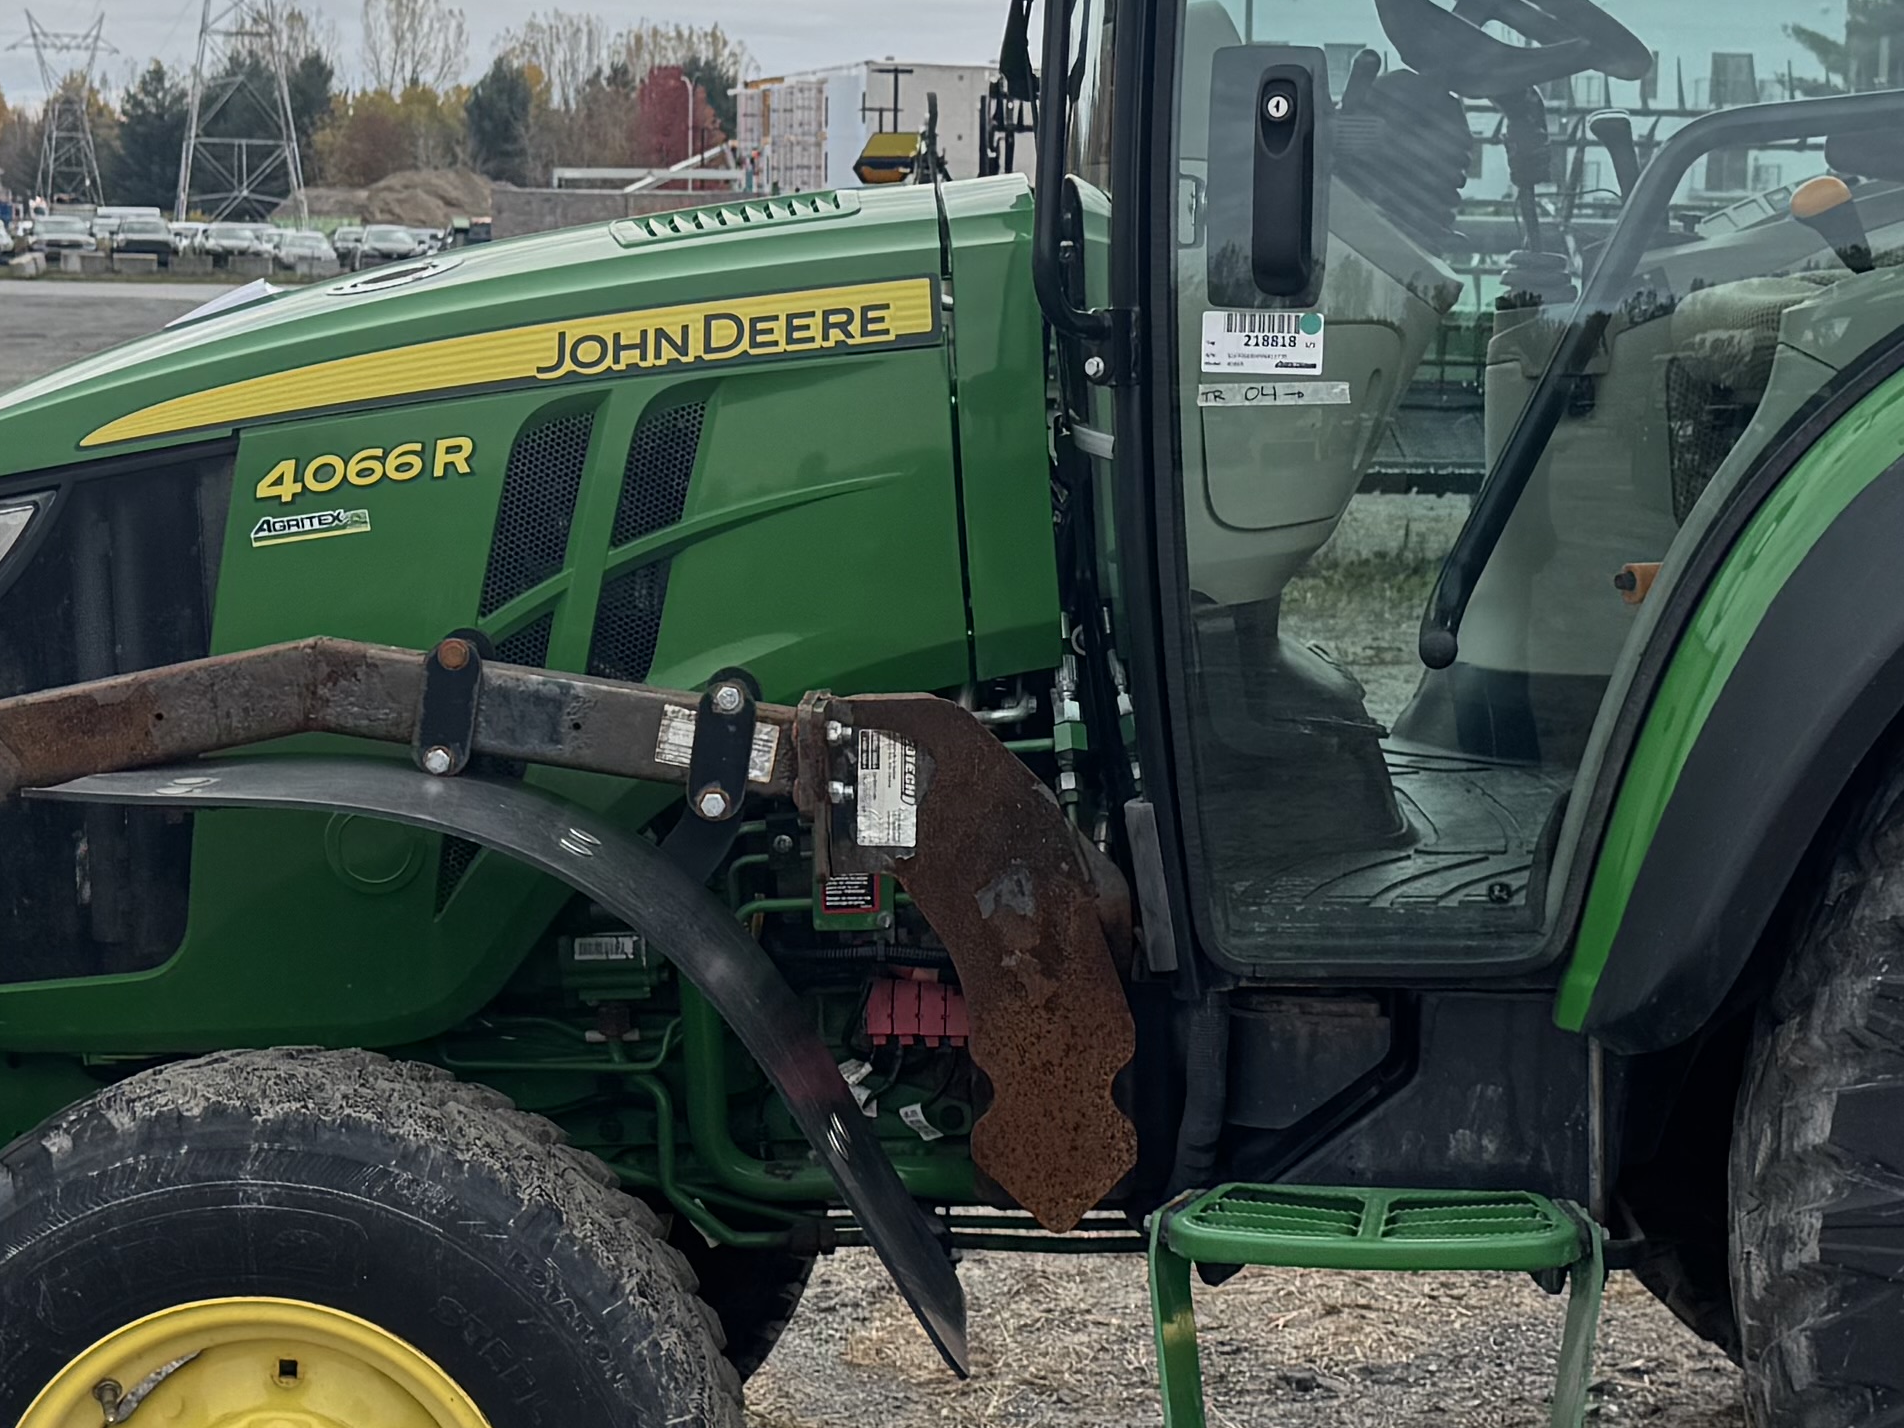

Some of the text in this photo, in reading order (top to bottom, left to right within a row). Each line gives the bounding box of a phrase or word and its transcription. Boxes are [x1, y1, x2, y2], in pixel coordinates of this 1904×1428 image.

[536, 302, 891, 374] JOHN DEERE
[1243, 334, 1297, 348] 218818
[1200, 389, 1226, 403] TR
[255, 441, 424, 503] 4066
[253, 509, 345, 536] AGRITEX
[905, 739, 917, 797] OTECH
